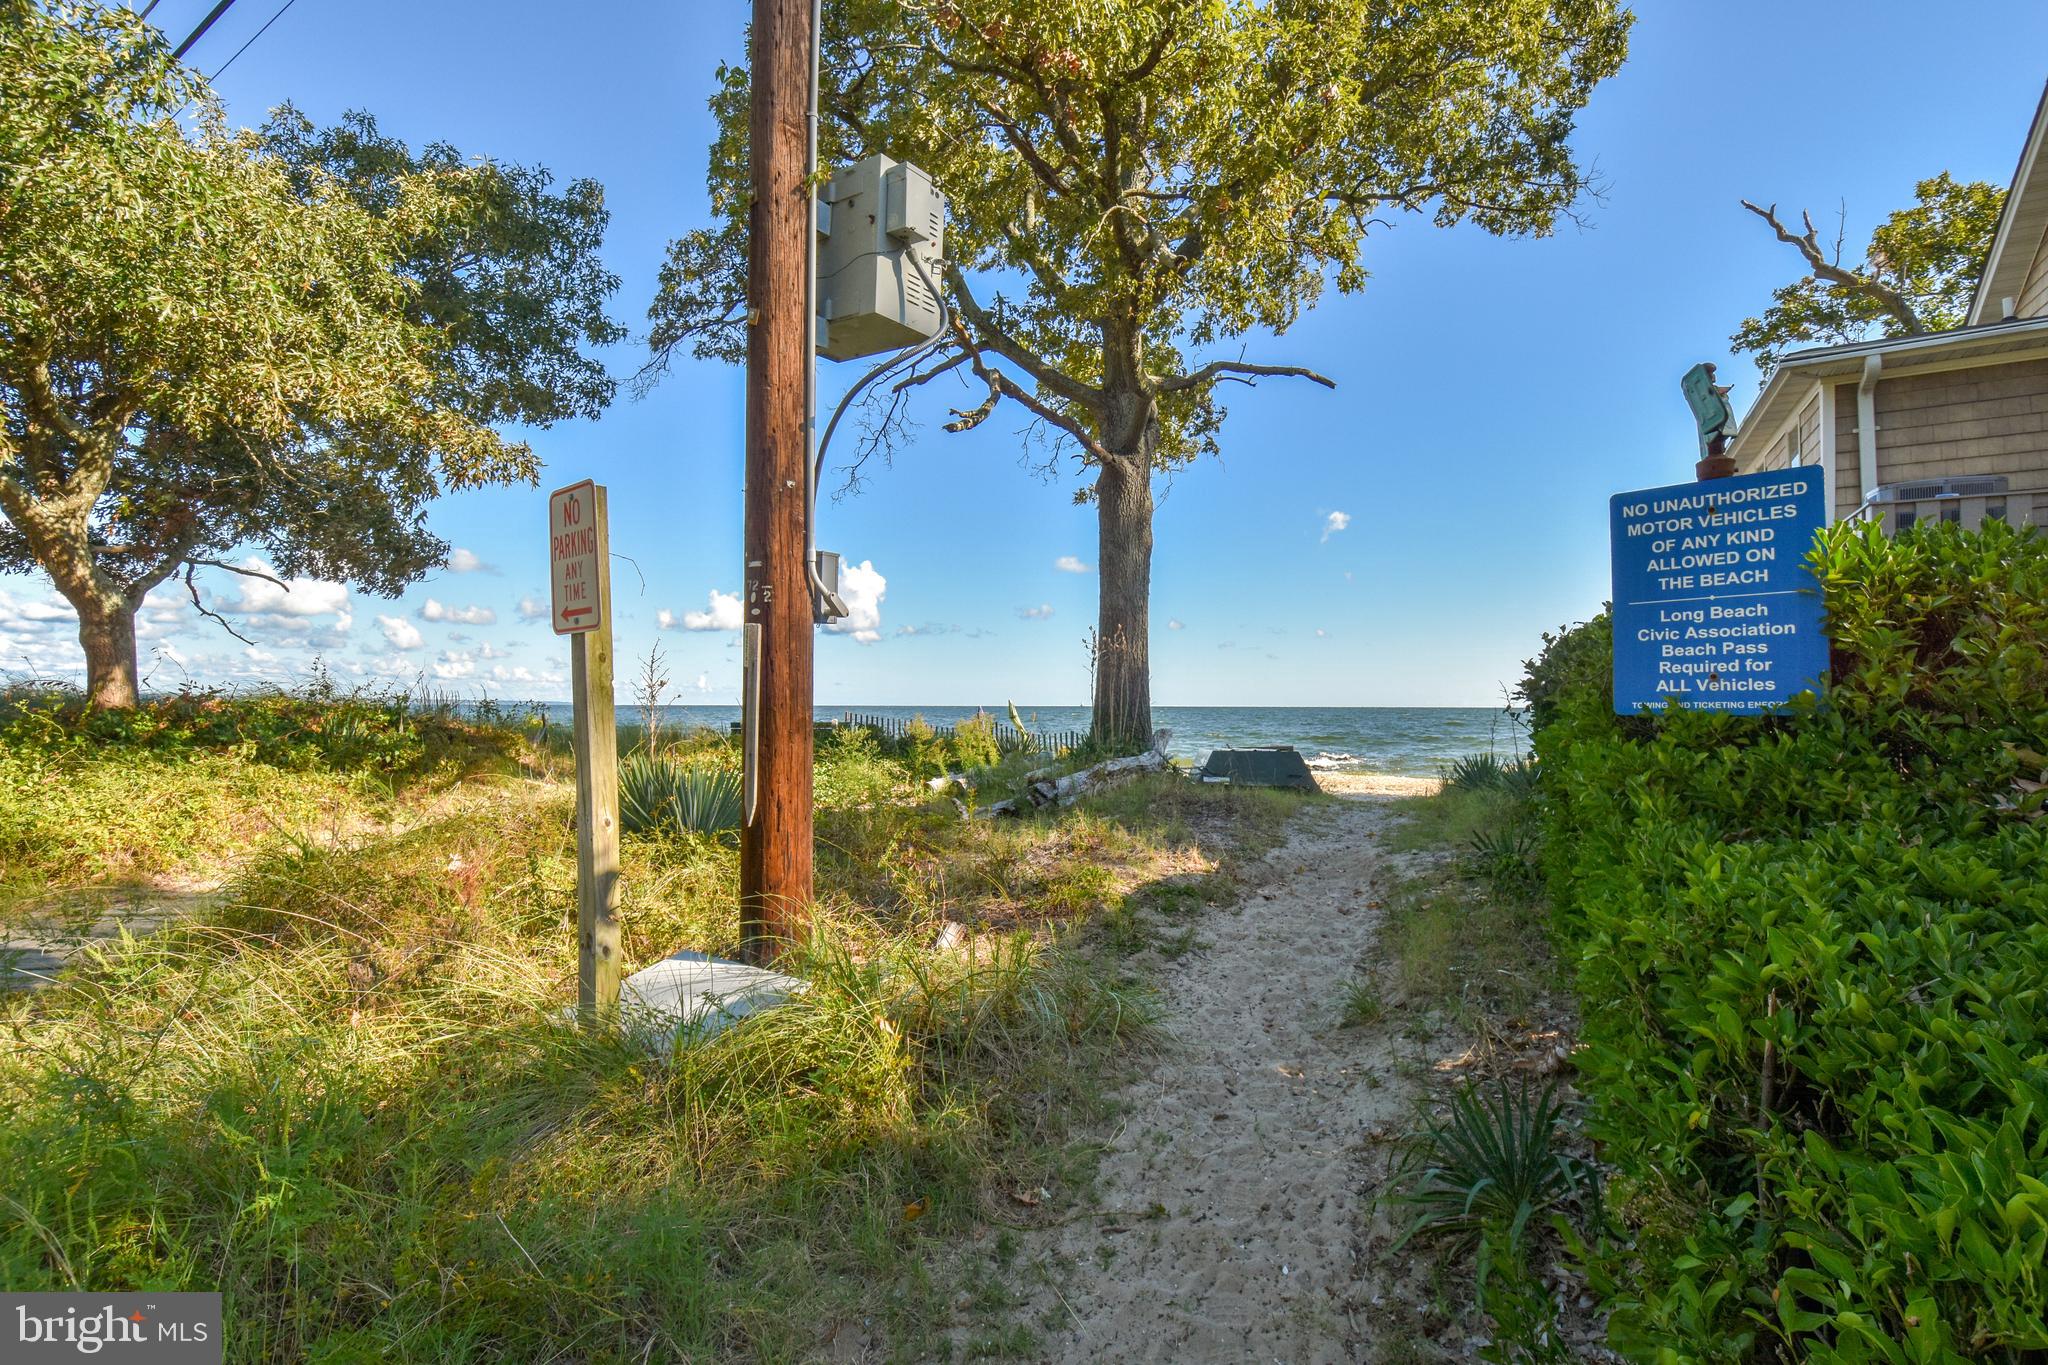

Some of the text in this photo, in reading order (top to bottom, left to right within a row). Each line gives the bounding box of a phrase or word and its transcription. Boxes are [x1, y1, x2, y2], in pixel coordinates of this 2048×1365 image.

[1623, 481, 1807, 518] NO UNAUTHORIZED
[564, 499, 580, 526] NO
[1628, 504, 1797, 536] MOTOR VEHICLES
[553, 529, 593, 562] PARKING
[1652, 528, 1775, 553] OF ANY KIND
[1647, 548, 1776, 572] ALLOWED ON
[566, 561, 583, 580] ANY
[1658, 569, 1769, 590] THE BEACH
[564, 582, 586, 602] TIME
[1660, 604, 1768, 623] Long Beach
[1637, 622, 1796, 641] Civic Association
[1662, 641, 1768, 657] Beach Pass
[1659, 659, 1772, 676] Required for
[1656, 677, 1776, 692] ALL Vehicles
[1693, 701, 1744, 709] TICKETING
